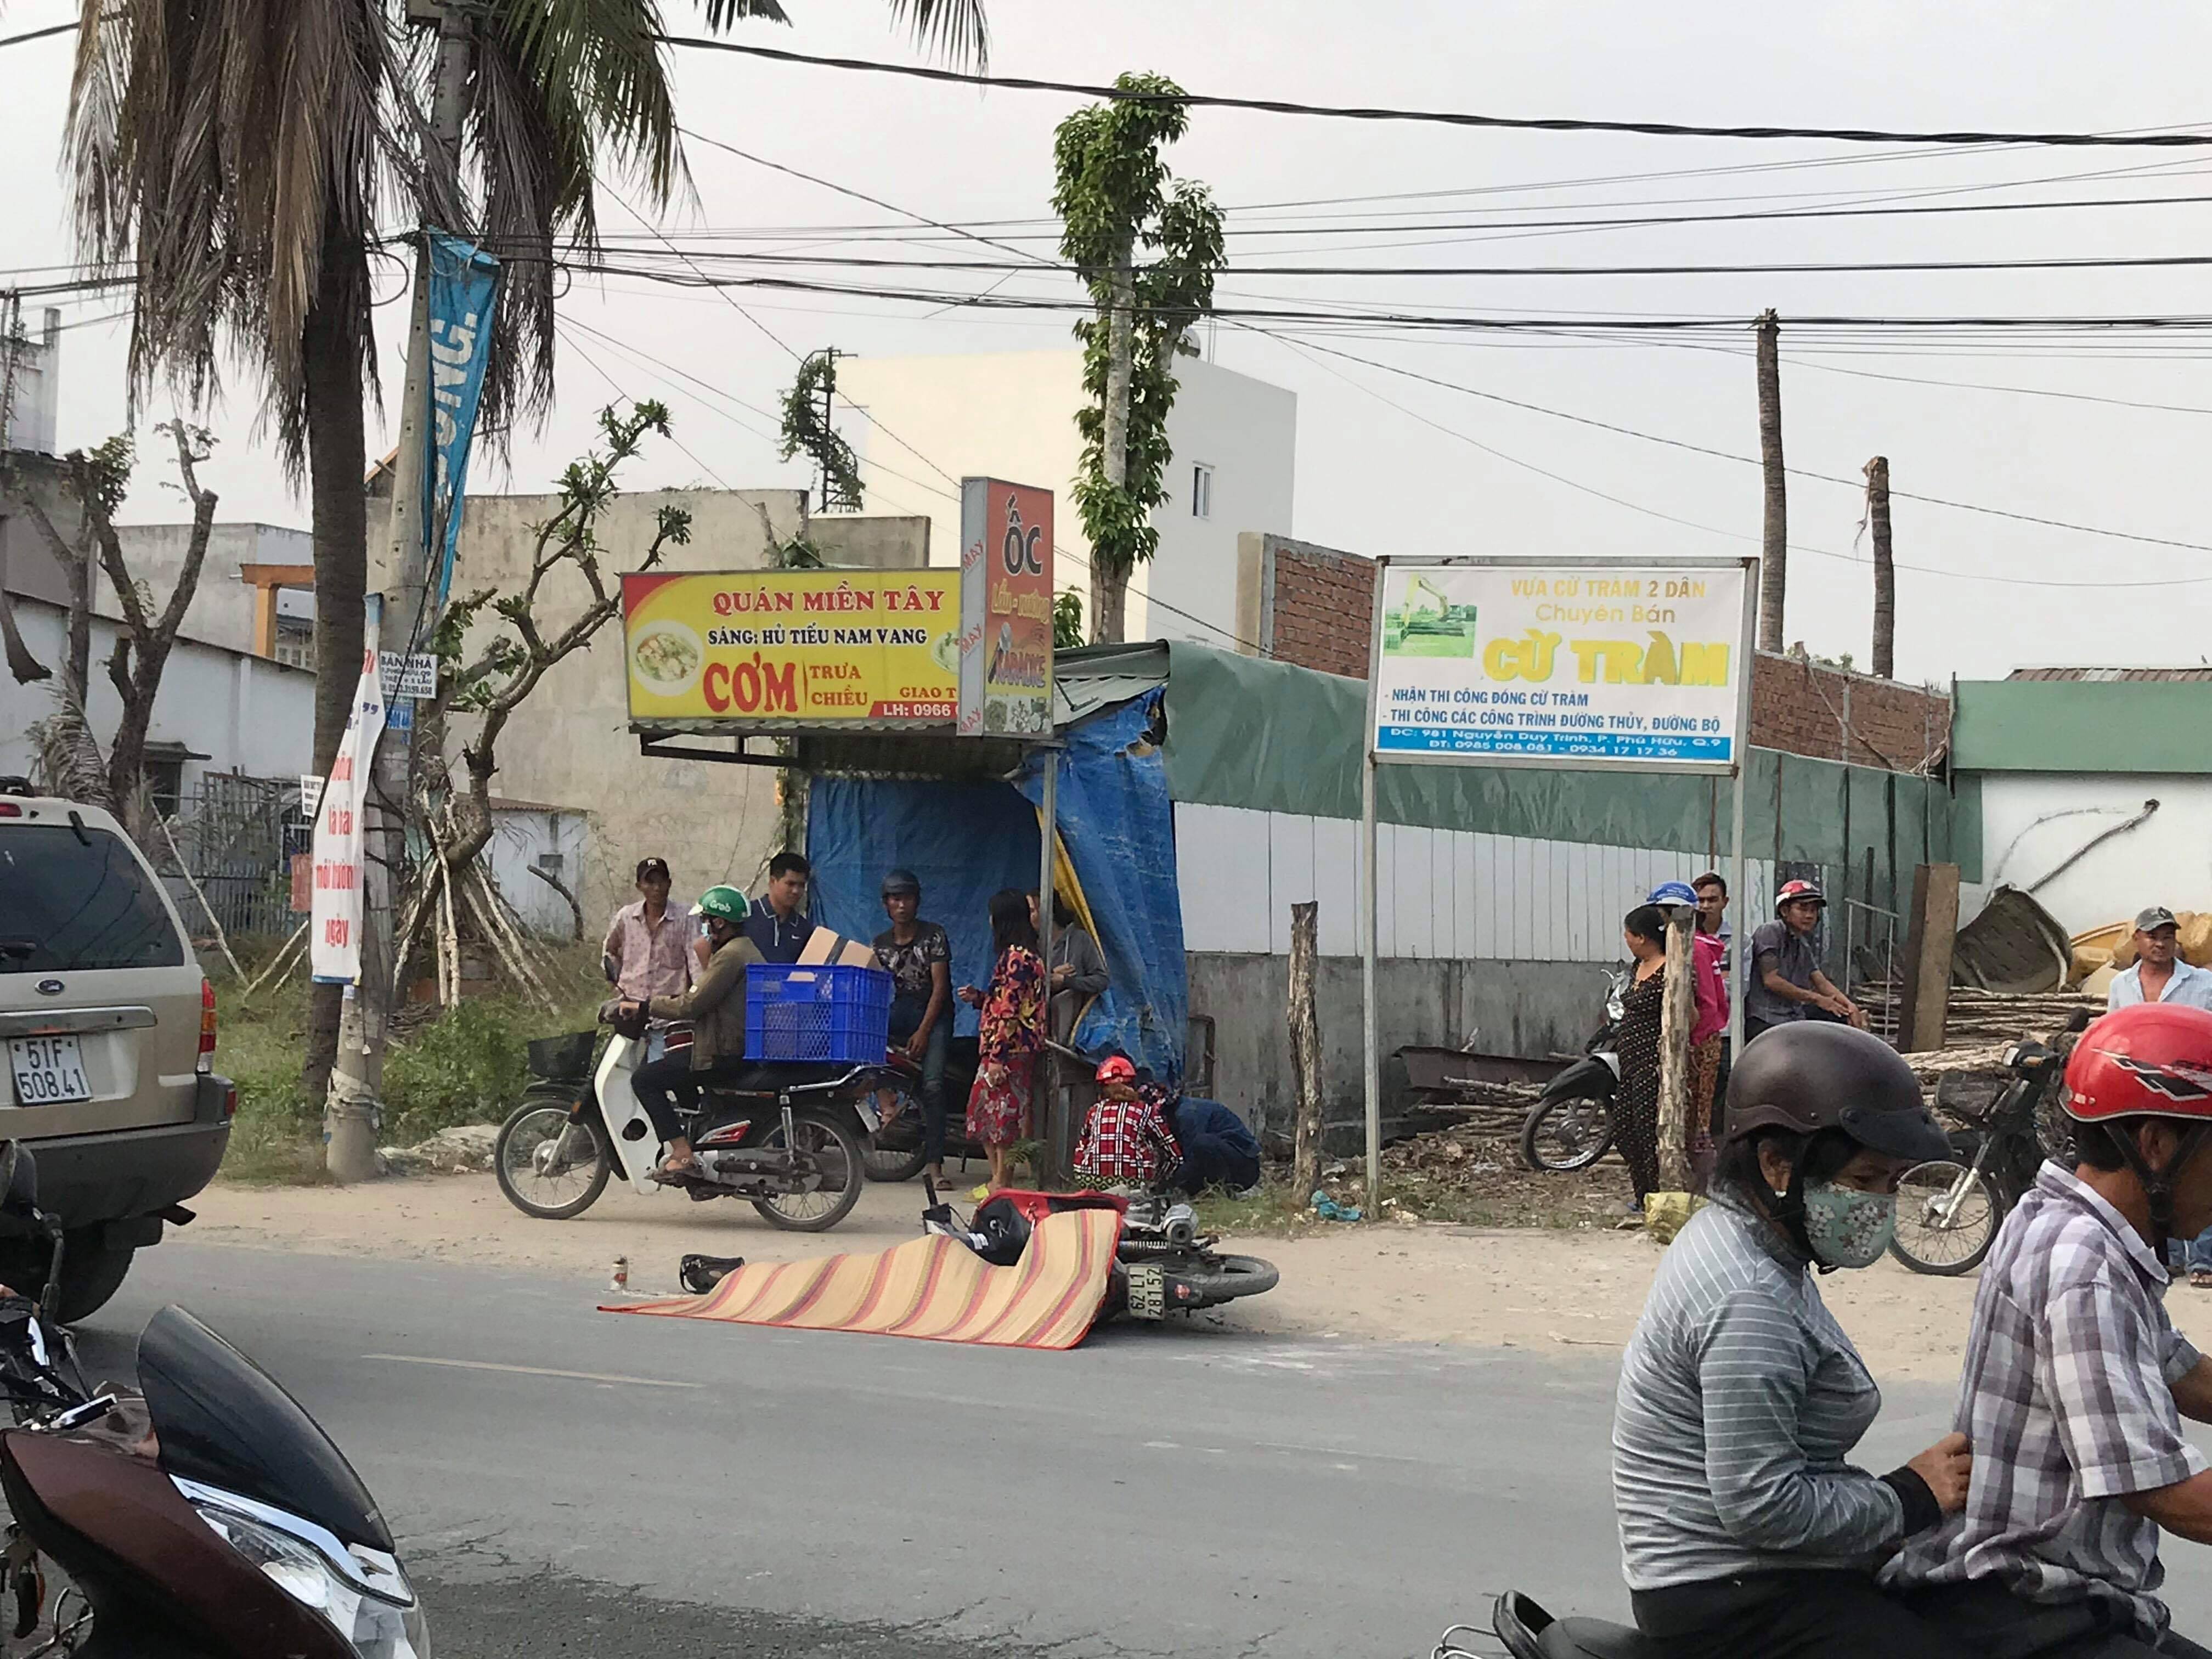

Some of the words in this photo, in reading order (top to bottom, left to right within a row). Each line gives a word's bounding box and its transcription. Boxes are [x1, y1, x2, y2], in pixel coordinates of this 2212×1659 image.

[1004, 492, 1042, 576] ỐC
[713, 586, 794, 616] QUÁN
[803, 580, 875, 612] MIỀN
[883, 584, 945, 611] TÂY
[1511, 577, 1548, 600] VỰA
[1647, 580, 1658, 597] 2
[1665, 576, 1706, 597] DÂN
[1536, 603, 1624, 625] Chuyên
[1631, 604, 1676, 623] Bán
[708, 623, 759, 645] SÁNG:
[763, 623, 786, 645] HỦ
[790, 622, 831, 645] TIẾU
[834, 629, 872, 645] NAM
[876, 629, 927, 645] VANG
[381, 653, 403, 667] BÁN
[406, 655, 432, 669] NHÀ
[1483, 628, 1562, 682] CỪ
[1570, 630, 1730, 686] TRÀM
[703, 652, 799, 713] CƠM
[810, 664, 862, 679] TRƯA
[811, 685, 868, 706] CHIỀU
[899, 687, 942, 698] GIAO
[1392, 686, 1426, 704] NHẬN
[1430, 690, 1450, 703] THI
[1454, 687, 1488, 704] CÔNG
[1492, 687, 1526, 705] ĐÓNG
[883, 704, 909, 716] LH:
[913, 704, 951, 716] 0966
[1391, 709, 1410, 722] THI
[1414, 707, 1447, 724] CÔNG
[1451, 707, 1477, 724] CÁC
[1481, 709, 1514, 725] CÔNG
[1518, 710, 1556, 726] TRÌNH
[1560, 712, 1605, 729] ĐƯỜNG
[1652, 714, 1697, 731] ĐƯỜNG
[1702, 715, 1720, 734] BỘ
[1519, 732, 1548, 742] Duy
[1570, 744, 1606, 753] 0934
[1613, 746, 1629, 755] 17
[1637, 747, 1654, 755] 17
[1657, 747, 1678, 756] 36
[709, 900, 731, 913] Grab
[26, 1039, 63, 1069] 51F
[18, 1068, 87, 1101] 508.41
[1147, 1267, 1163, 1317] 281.52
